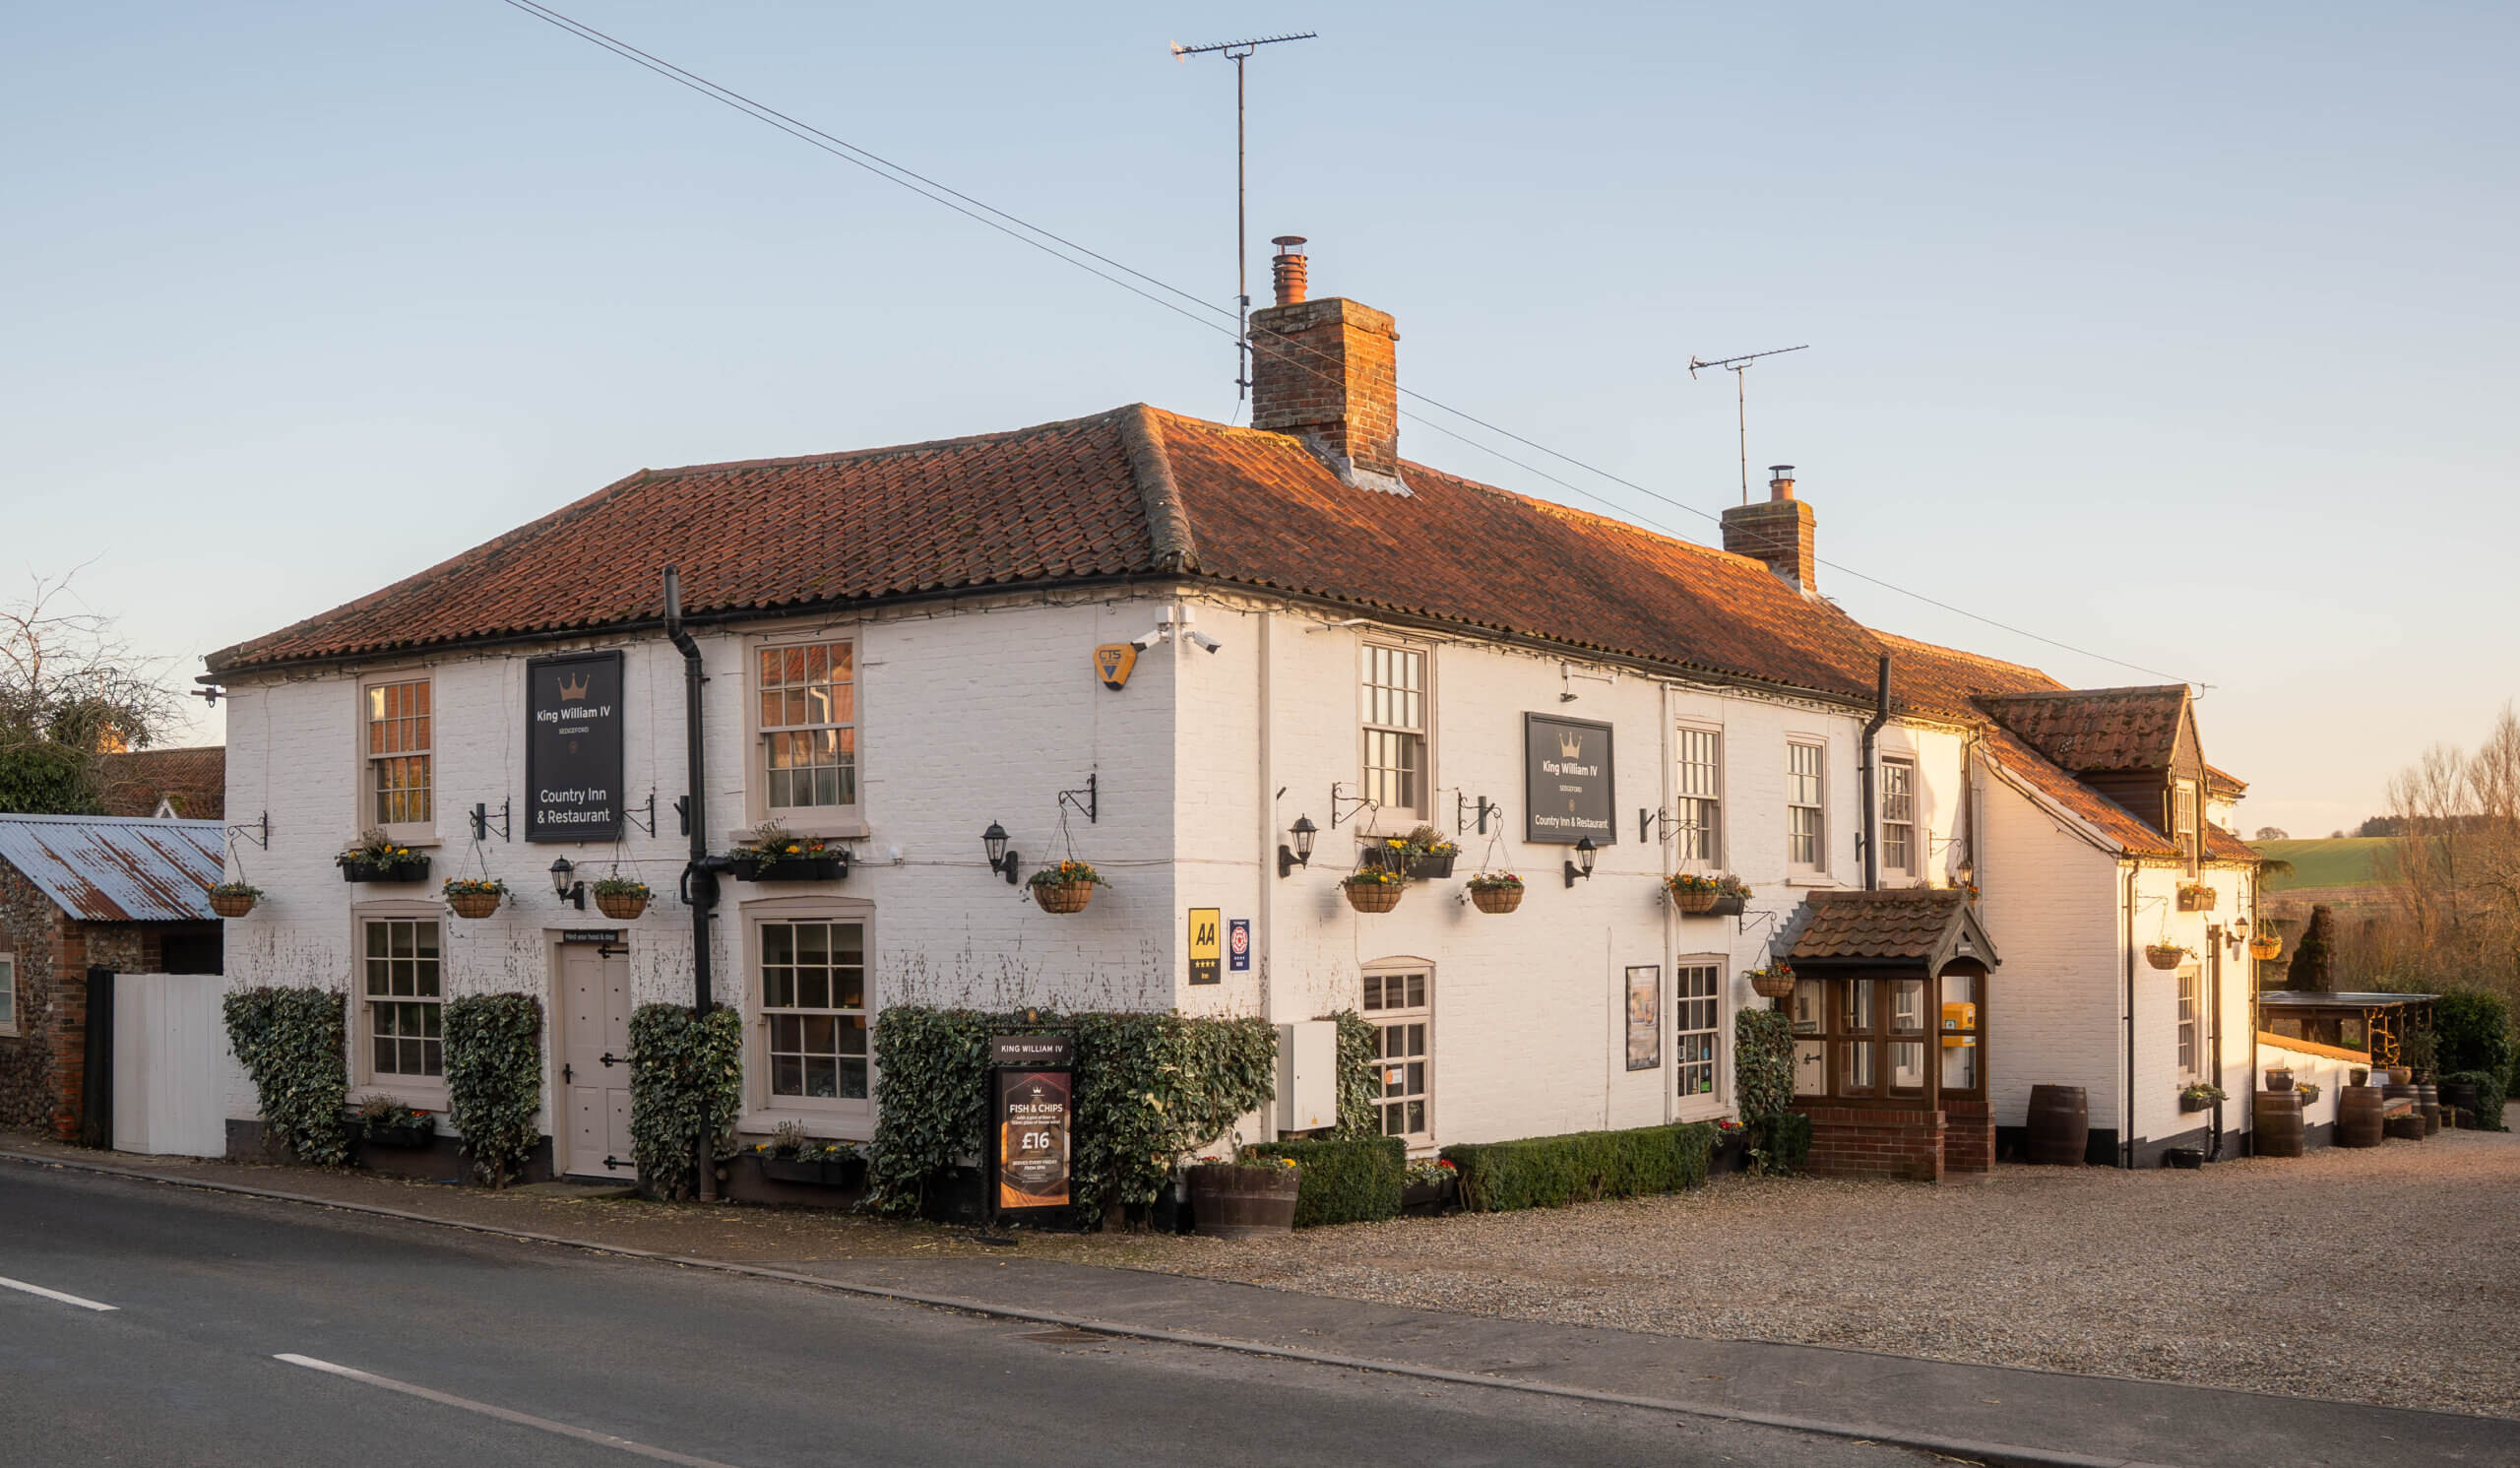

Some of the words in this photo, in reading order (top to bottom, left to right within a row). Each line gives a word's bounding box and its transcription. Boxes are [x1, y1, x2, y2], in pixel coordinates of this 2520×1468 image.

[536, 710, 558, 723] King
[560, 707, 598, 720] William
[600, 705, 610, 717] IV
[1543, 760, 1560, 776] King
[1561, 762, 1589, 777] William
[1590, 765, 1598, 777] IV
[540, 789, 586, 805] Country
[588, 787, 606, 801] Inn
[536, 810, 545, 824] &
[547, 807, 610, 824] Restaurant
[1536, 814, 1559, 829] Country
[1560, 815, 1571, 827] Inn
[1571, 816, 1576, 827] &
[1576, 817, 1608, 829] Restaurant
[1196, 923, 1215, 945] AA
[1009, 1104, 1030, 1114] FISH
[1031, 1104, 1037, 1113] &
[1038, 1103, 1063, 1113] CHIPS
[1022, 1132, 1049, 1150] £16
